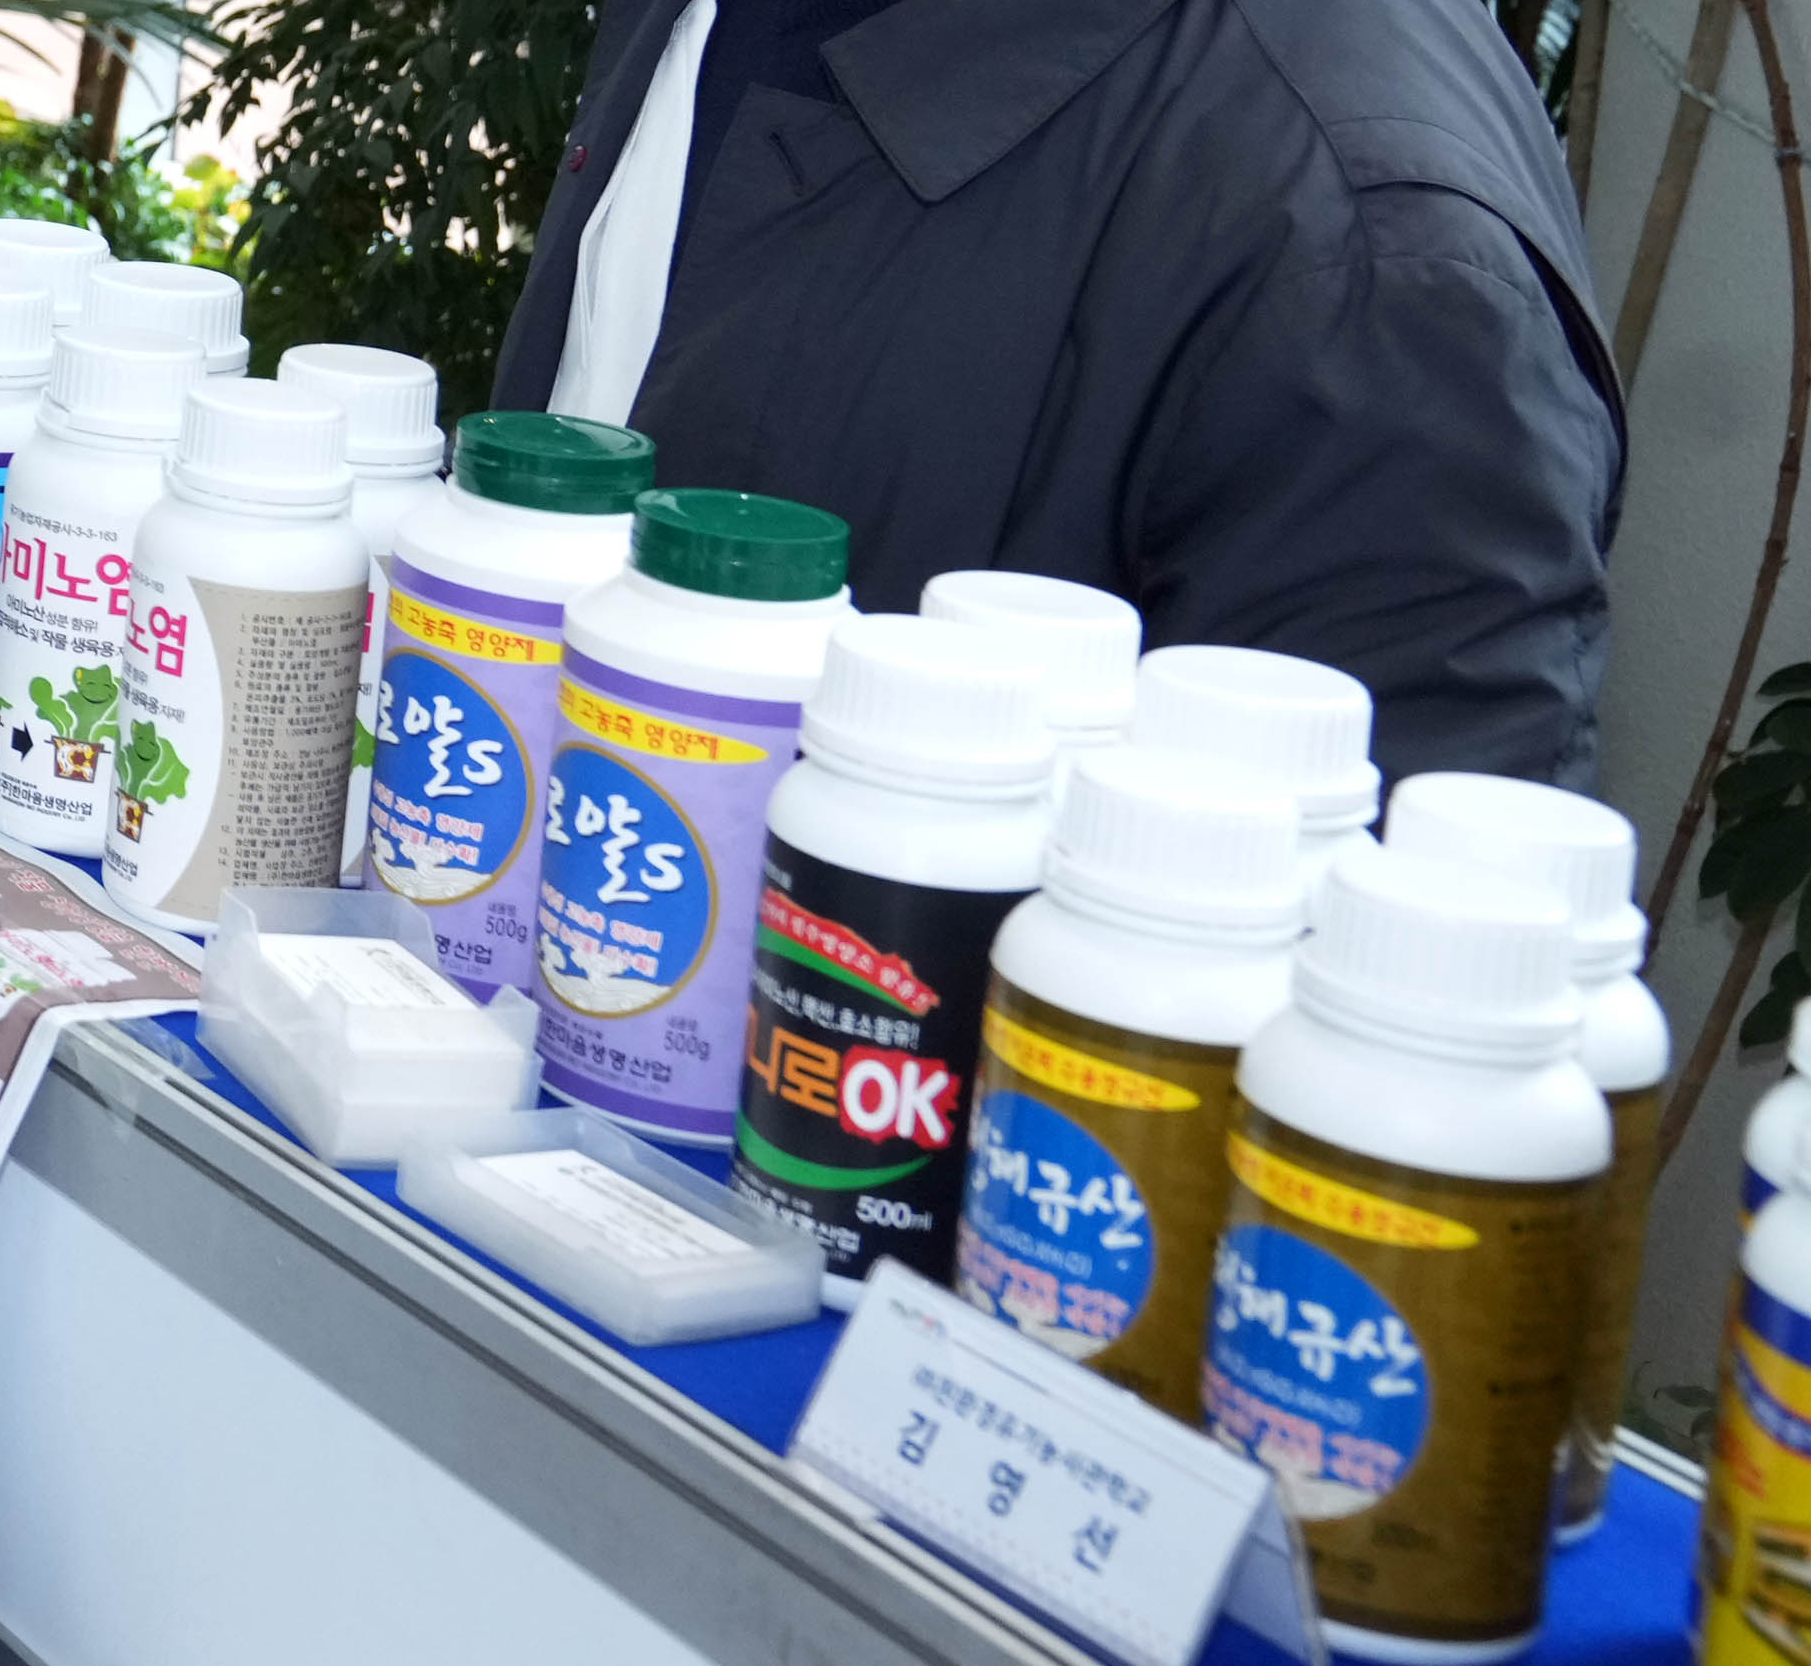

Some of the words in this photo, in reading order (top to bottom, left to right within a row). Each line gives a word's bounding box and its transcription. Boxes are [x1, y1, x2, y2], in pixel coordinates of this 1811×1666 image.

[463, 625, 537, 663] 영양제
[641, 723, 720, 762] 영양제
[483, 915, 529, 944] 500g
[662, 1030, 712, 1062] 500g
[984, 1456, 1030, 1520] 영
